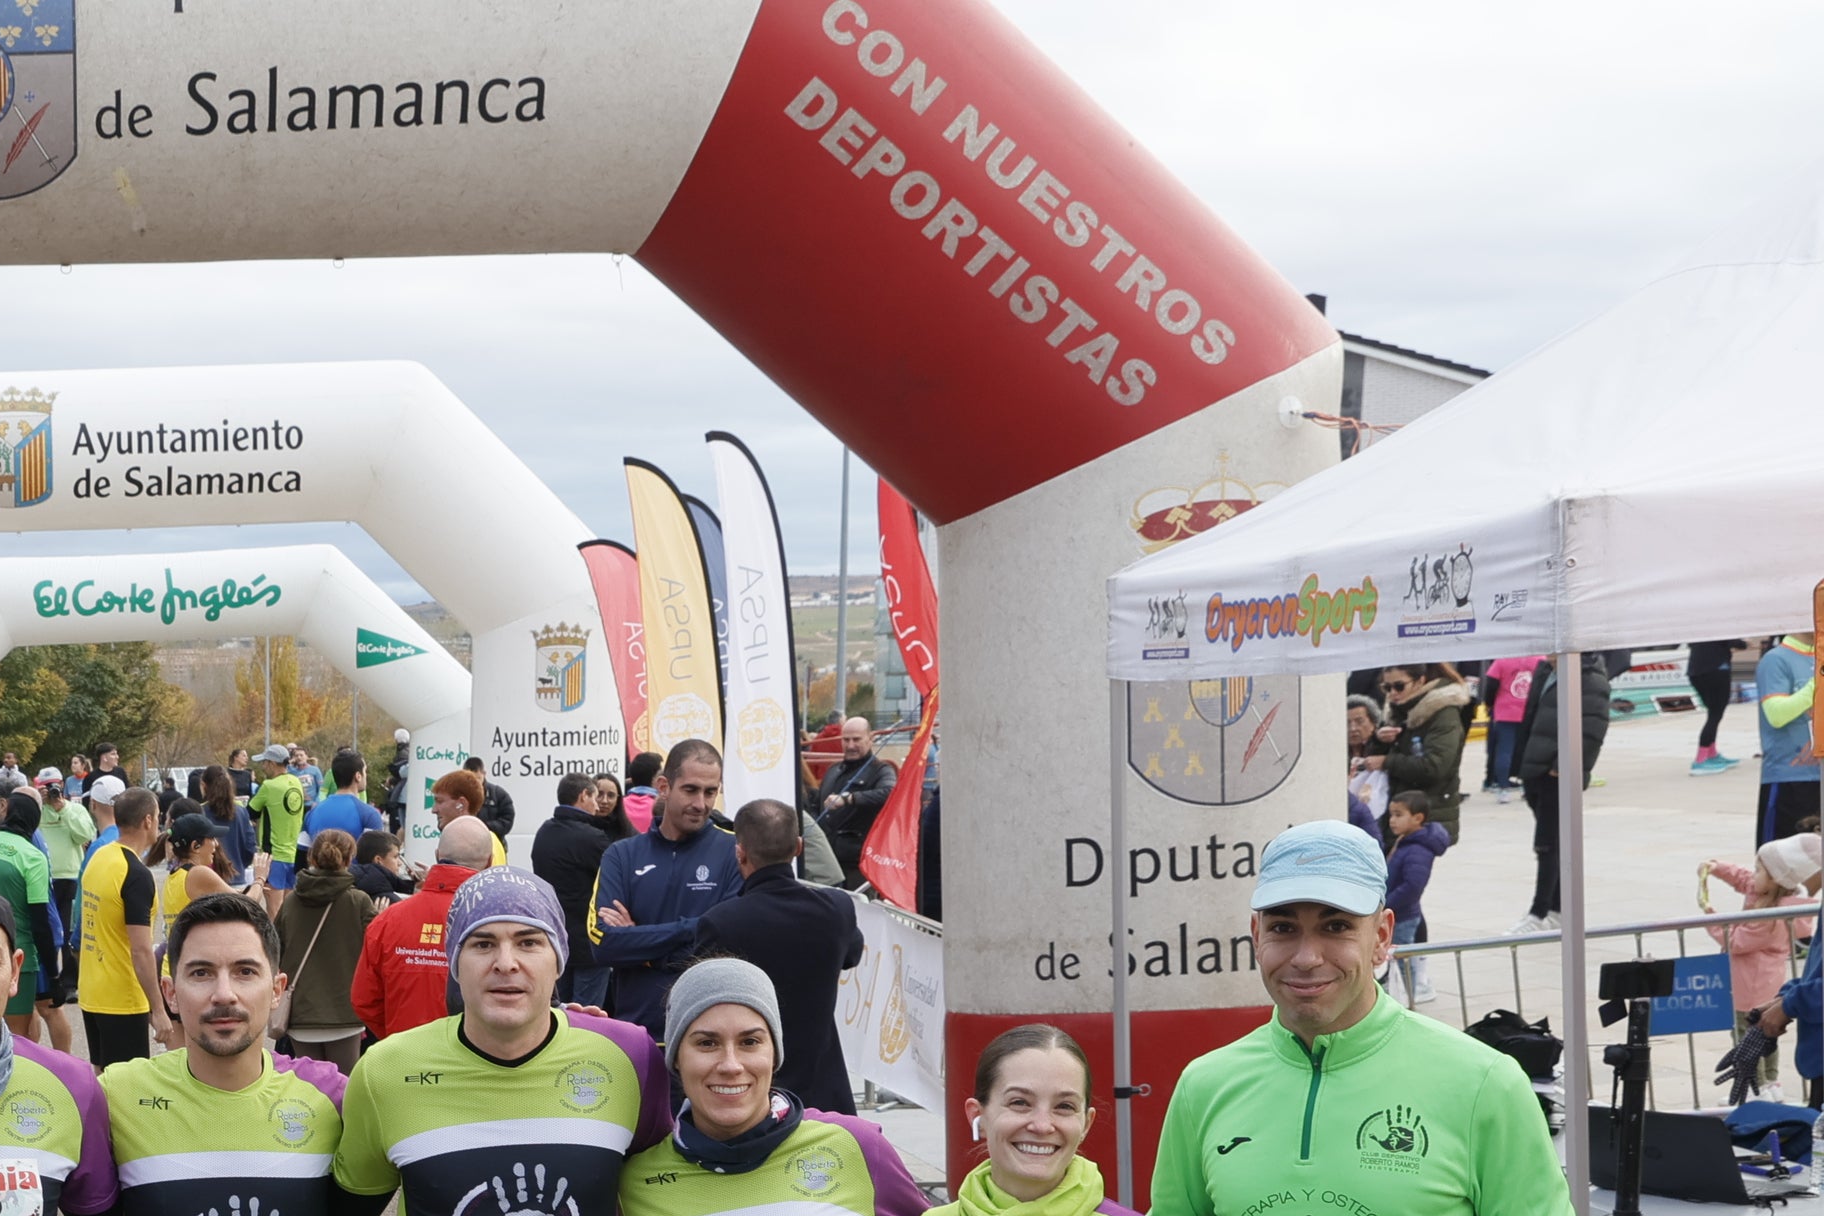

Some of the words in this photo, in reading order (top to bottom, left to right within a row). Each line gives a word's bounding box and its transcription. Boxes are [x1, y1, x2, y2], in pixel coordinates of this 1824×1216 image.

[95, 90, 154, 140] de
[185, 66, 547, 137] Salamanca
[821, 0, 947, 116] CON
[942, 103, 1236, 365] NUESTROS
[783, 76, 1157, 406] DEPORTISTAS
[72, 419, 304, 463] Ayuntamiento
[73, 468, 111, 499] de
[124, 466, 302, 497] Salamanca
[33, 580, 70, 617] El
[72, 580, 155, 616] Corte
[161, 568, 282, 625] Inglés
[492, 725, 620, 752] Ayuntamiento
[417, 746, 425, 760] El
[426, 747, 454, 761] Corte
[492, 757, 511, 777] de
[519, 755, 619, 777] Salamanca
[395, 946, 432, 957] Universidad
[405, 957, 414, 965] de
[414, 956, 448, 966] Salamanca
[1035, 941, 1081, 981] de
[1674, 974, 1723, 991] LICIA
[1654, 995, 1719, 1011] LOCAL
[567, 1073, 605, 1086] Roberto
[573, 1086, 602, 1097] Ramos
[10, 1102, 47, 1115] Roberto
[17, 1115, 45, 1127] Ramos
[1302, 1189, 1315, 1200] Y
